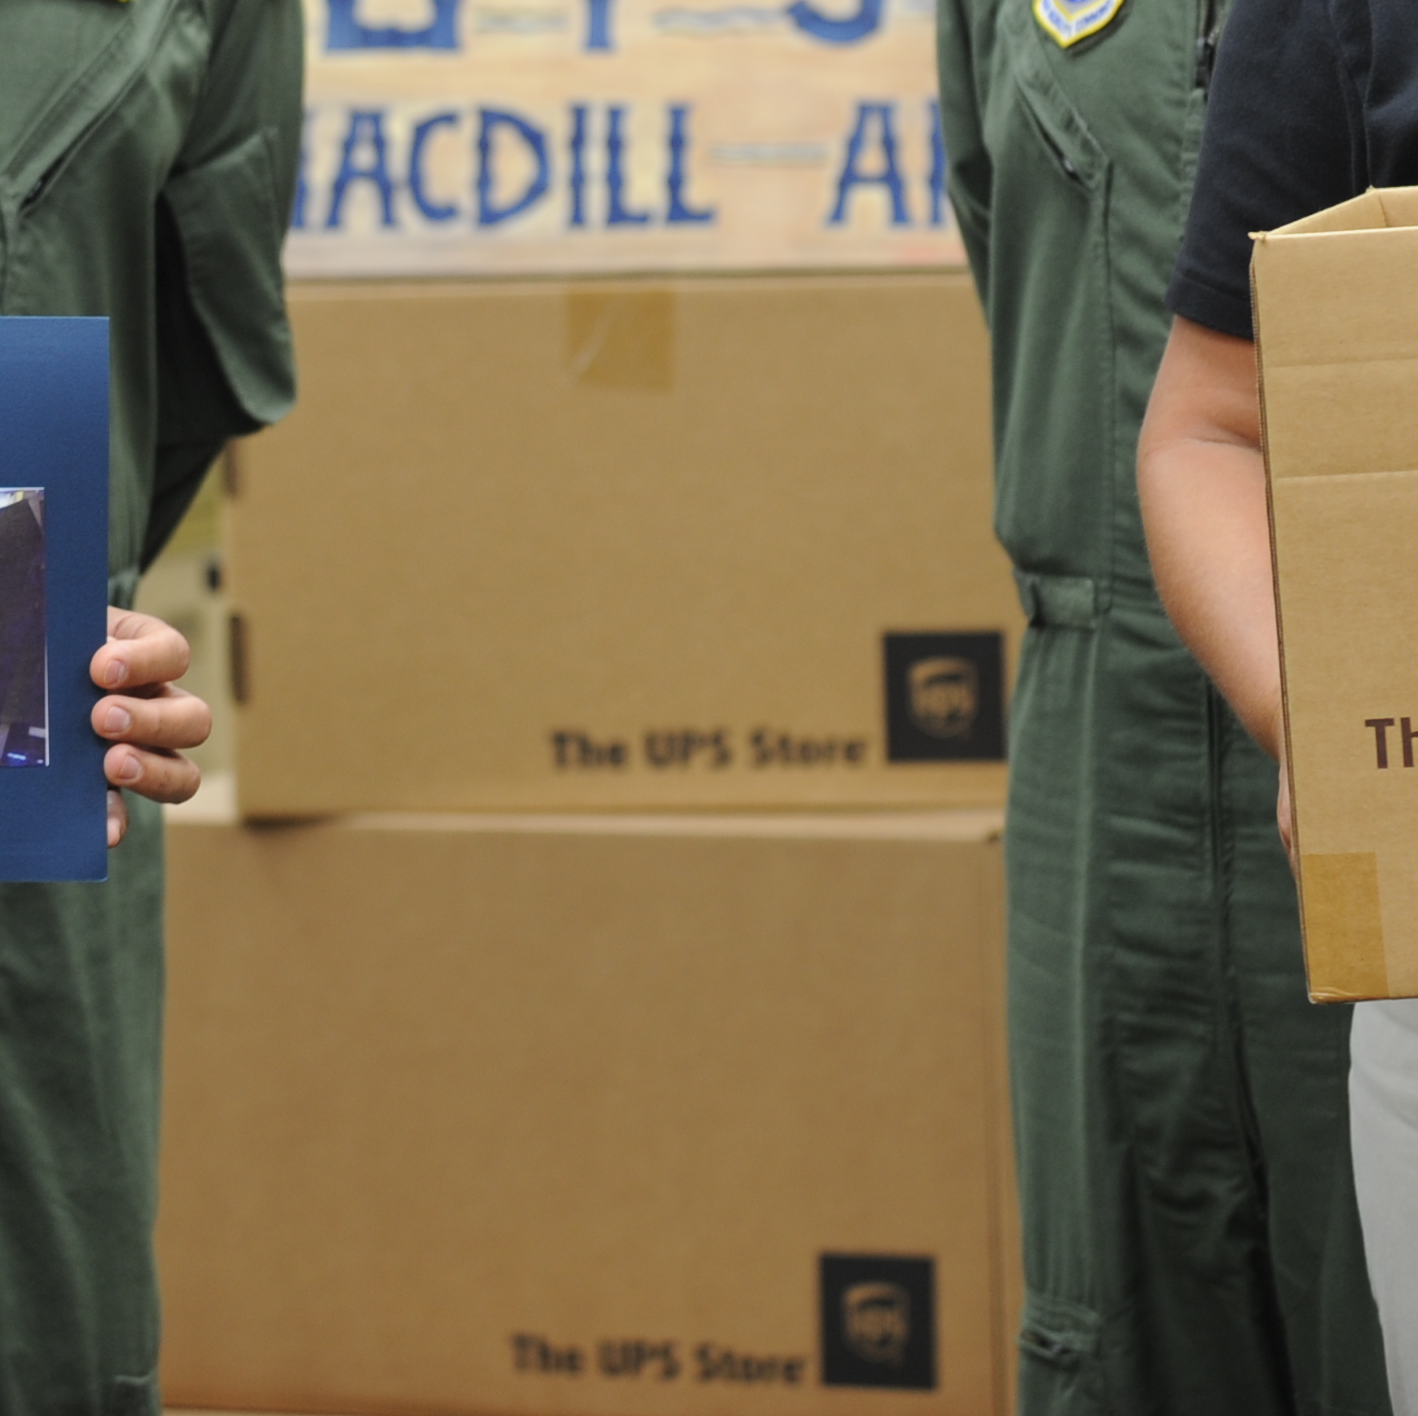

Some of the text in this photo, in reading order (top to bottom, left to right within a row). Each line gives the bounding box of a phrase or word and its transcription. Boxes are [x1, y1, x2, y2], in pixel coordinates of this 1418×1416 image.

[549, 729, 868, 769] The UPS Store
[511, 1331, 584, 1376] The
[596, 1336, 682, 1381] UPS
